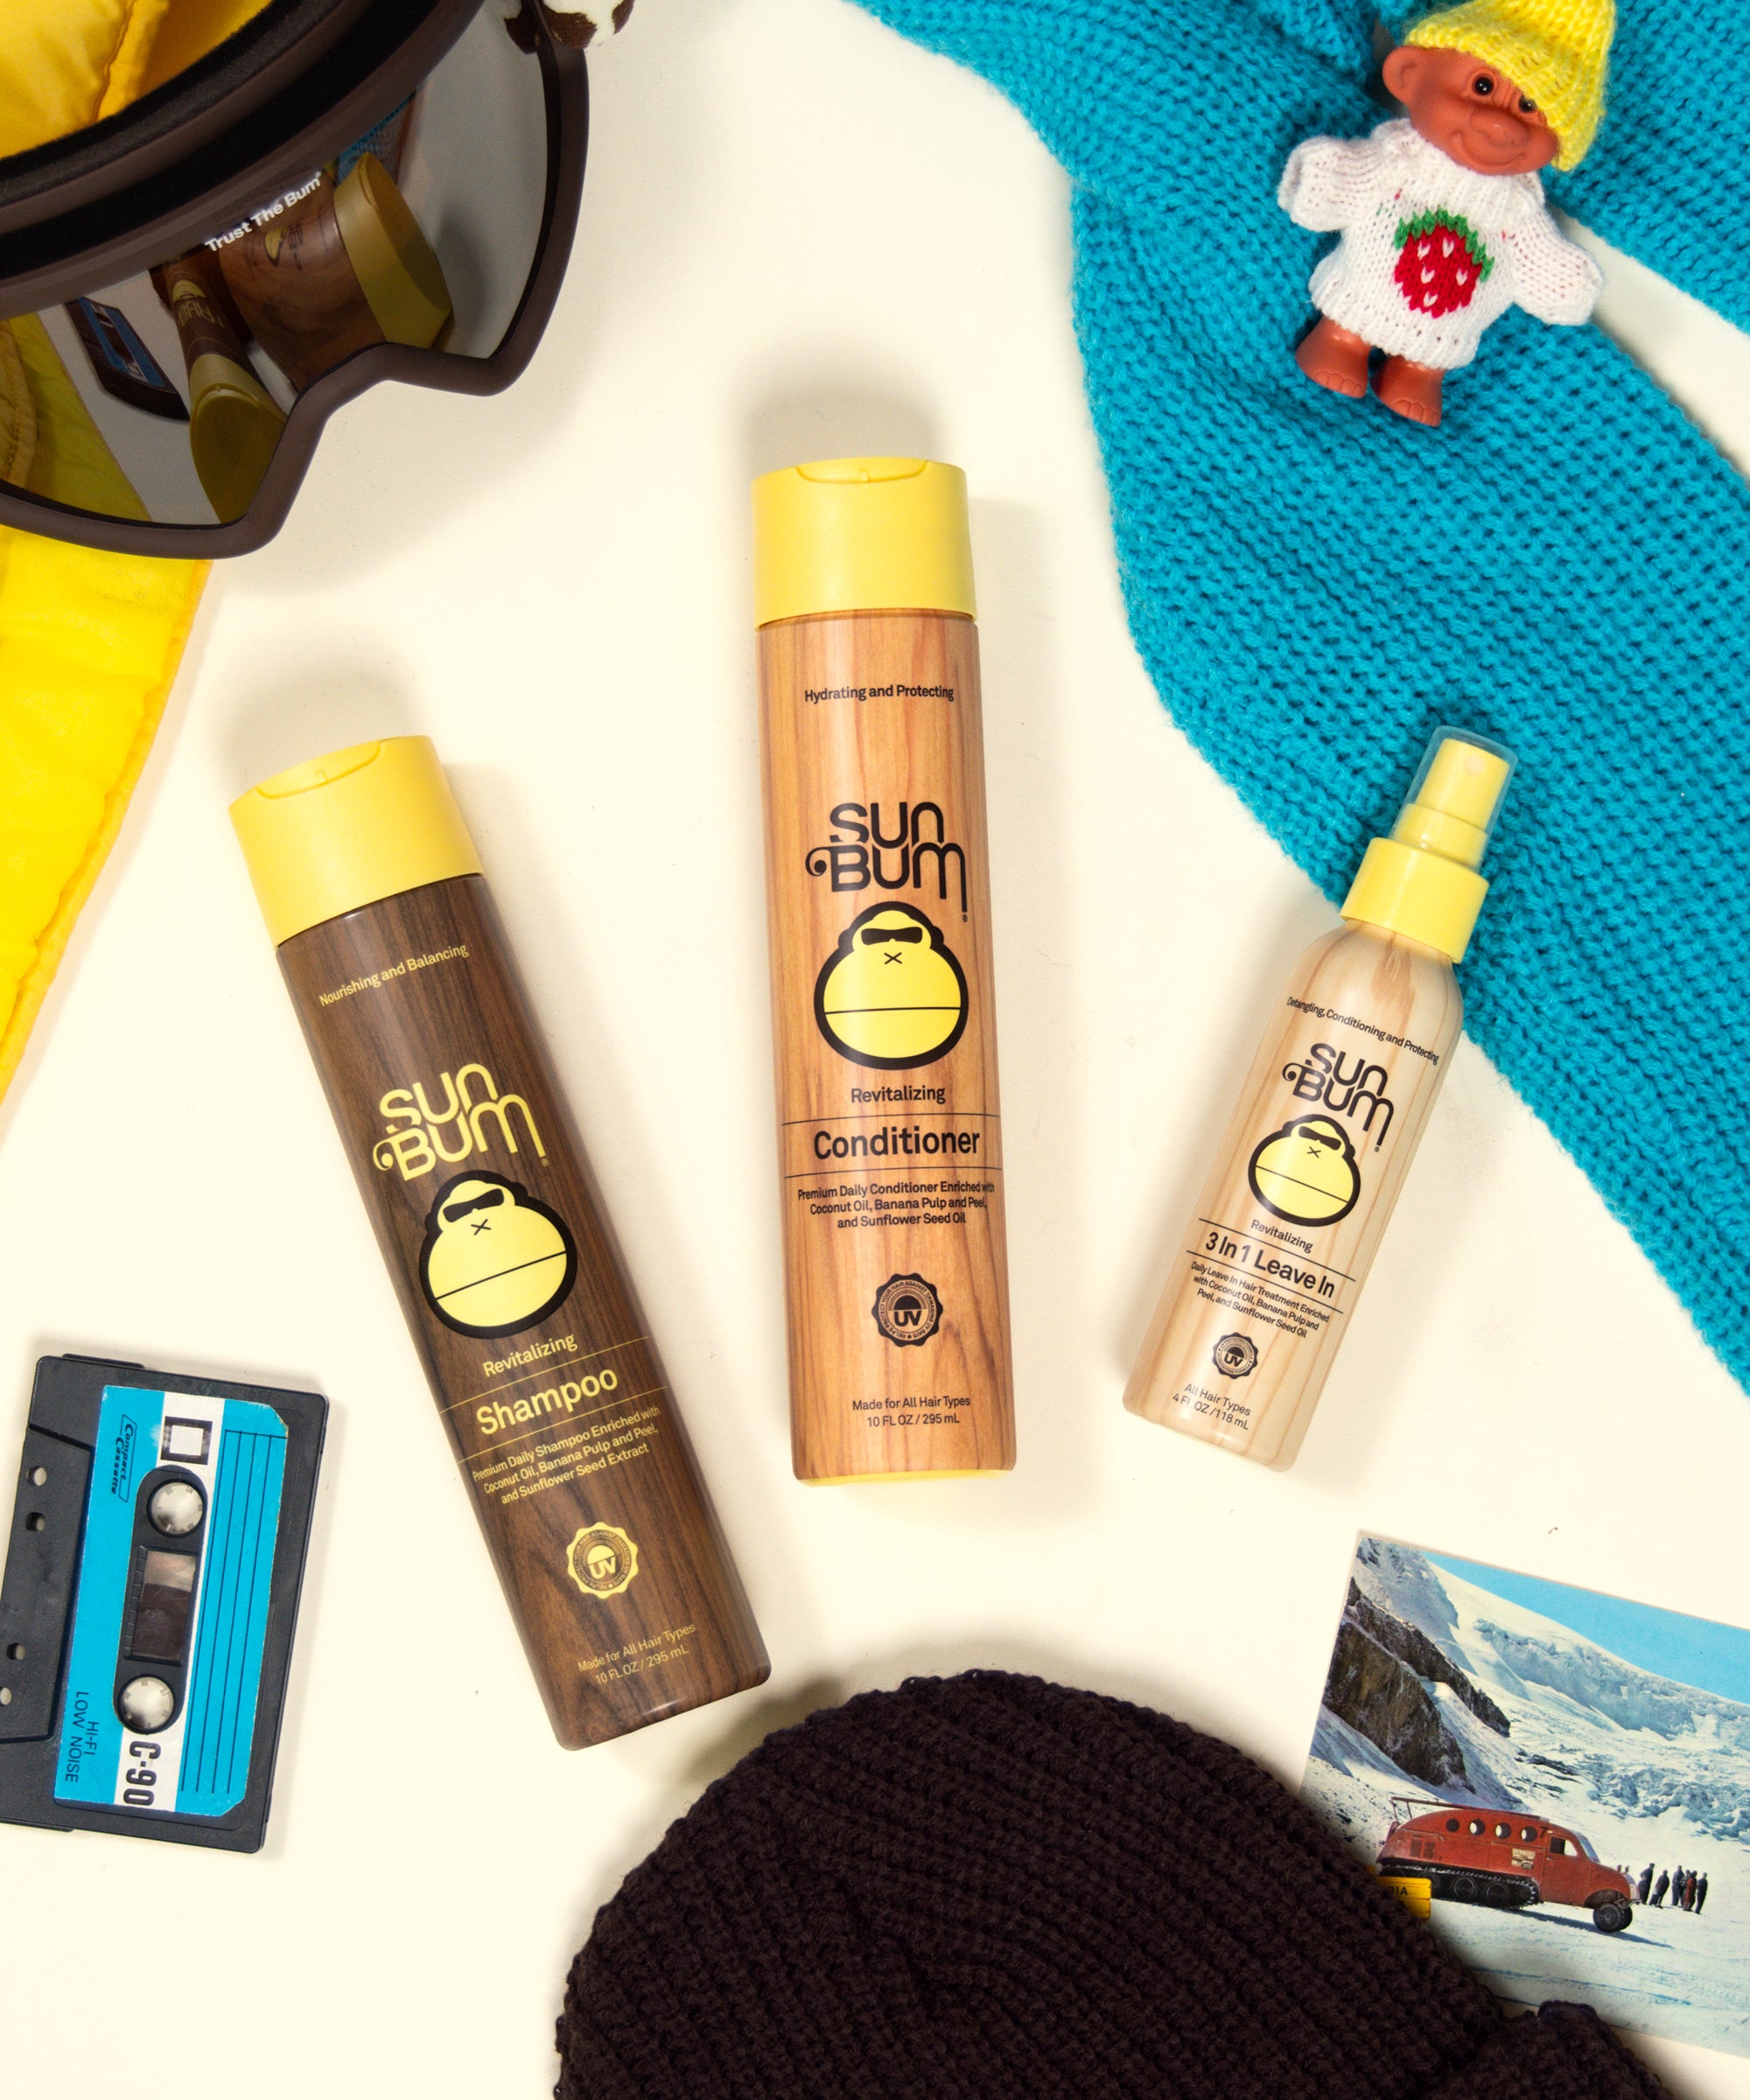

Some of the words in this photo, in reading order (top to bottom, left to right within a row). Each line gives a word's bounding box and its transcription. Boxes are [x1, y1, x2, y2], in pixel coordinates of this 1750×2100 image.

[205, 221, 253, 252] Trust
[250, 203, 284, 227] The
[804, 686, 867, 704] Hydrating
[869, 684, 894, 697] and
[896, 684, 955, 702] Protecting
[318, 973, 382, 1006] Nourishing
[381, 962, 406, 981] and
[406, 944, 469, 971] Balancing
[1286, 996, 1326, 1018] Detangling,
[1326, 1009, 1386, 1042] Conditioning
[1385, 1033, 1404, 1047] and
[1404, 1040, 1439, 1066] Protecting
[850, 1084, 946, 1105] Revitalizing
[814, 1125, 980, 1160] Conditioner
[797, 1186, 837, 1200] Premium
[839, 1184, 868, 1199] Daily
[870, 1181, 938, 1195] Conditioner
[940, 1180, 981, 1193] Enriched
[981, 1182, 995, 1194] with
[810, 1200, 851, 1215] Coconut
[853, 1199, 873, 1214] Oil,
[874, 1197, 920, 1211] Banana
[921, 1196, 947, 1211] Pulp
[948, 1196, 967, 1208] and
[837, 1215, 858, 1228] and
[860, 1213, 921, 1227] Sunflower
[923, 1212, 951, 1225] Seed
[953, 1211, 966, 1223] Oil
[1250, 1219, 1313, 1254] Revitalizing
[1205, 1231, 1219, 1251] 3
[1218, 1236, 1237, 1259] In
[1241, 1244, 1251, 1264] 1
[1253, 1250, 1317, 1290] Leave
[1318, 1275, 1335, 1298] In
[1190, 1261, 1208, 1275] Daily
[1207, 1267, 1229, 1282] Leave
[1228, 1275, 1239, 1284] In
[1238, 1278, 1257, 1292] Hair
[1256, 1285, 1300, 1310] Treatment
[1299, 1304, 1330, 1322] Enriched
[1194, 1274, 1208, 1287] with
[1208, 1280, 1242, 1300] Coconut
[1242, 1292, 1256, 1306] Oil,
[1256, 1298, 1288, 1318] Banana
[1288, 1311, 1306, 1326] Pulp
[1306, 1319, 1320, 1331] and
[893, 1310, 922, 1326] UV
[1196, 1287, 1215, 1303] Peel,
[1214, 1295, 1232, 1308] and
[1231, 1302, 1276, 1326] Sunflower
[1275, 1319, 1297, 1334] Seed
[1296, 1326, 1307, 1339] Oil
[482, 1334, 578, 1377] Revitalizing
[1224, 1353, 1243, 1368] UV
[476, 1368, 618, 1435] Shampoo
[852, 1399, 883, 1411] Made
[885, 1397, 900, 1409] for
[902, 1396, 917, 1408] All
[919, 1396, 942, 1408] Hair
[942, 1395, 970, 1409] Types
[866, 1416, 880, 1427] 10
[882, 1415, 897, 1426] FL
[898, 1414, 914, 1425] OZ
[915, 1414, 920, 1424] /
[922, 1413, 942, 1424] 295
[944, 1413, 960, 1424] mL
[1172, 1393, 1180, 1402] 4
[1194, 1401, 1210, 1414] OZ
[1234, 1419, 1249, 1431] mL
[1184, 1383, 1199, 1396] All
[1200, 1388, 1222, 1404] Hair
[1221, 1396, 1251, 1417] Types
[121, 1424, 134, 1480] Compact
[472, 1461, 508, 1482] Premium
[507, 1451, 535, 1468] Daily
[535, 1432, 591, 1458] Shampoo
[591, 1412, 640, 1438] Enriched
[640, 1405, 661, 1422] with
[483, 1473, 522, 1494] Coconut
[520, 1465, 540, 1480] Oil,
[538, 1451, 583, 1474] Banana
[582, 1439, 611, 1457] Pulp
[612, 1431, 634, 1447] and
[634, 1423, 659, 1439] Peel,
[111, 1437, 124, 1494] Cassette
[500, 1490, 520, 1505] and
[519, 1469, 575, 1498] Sunflower
[576, 1457, 607, 1477] Seed
[607, 1443, 649, 1466] Extract
[588, 1556, 616, 1579] UV
[578, 1656, 606, 1673] Made
[606, 1650, 621, 1663] for
[623, 1643, 638, 1657] All
[638, 1635, 662, 1652] Hair
[662, 1623, 696, 1642] Types
[594, 1672, 608, 1685] 10
[608, 1668, 623, 1681] FL
[622, 1661, 640, 1676] OZ
[640, 1658, 645, 1670] /
[646, 1651, 669, 1668] 295
[669, 1644, 690, 1659] mL
[72, 1691, 89, 1729] LOW
[83, 1721, 100, 1755] HI-FI
[65, 1736, 83, 1783] NOISE
[122, 1740, 162, 1806] C-90
